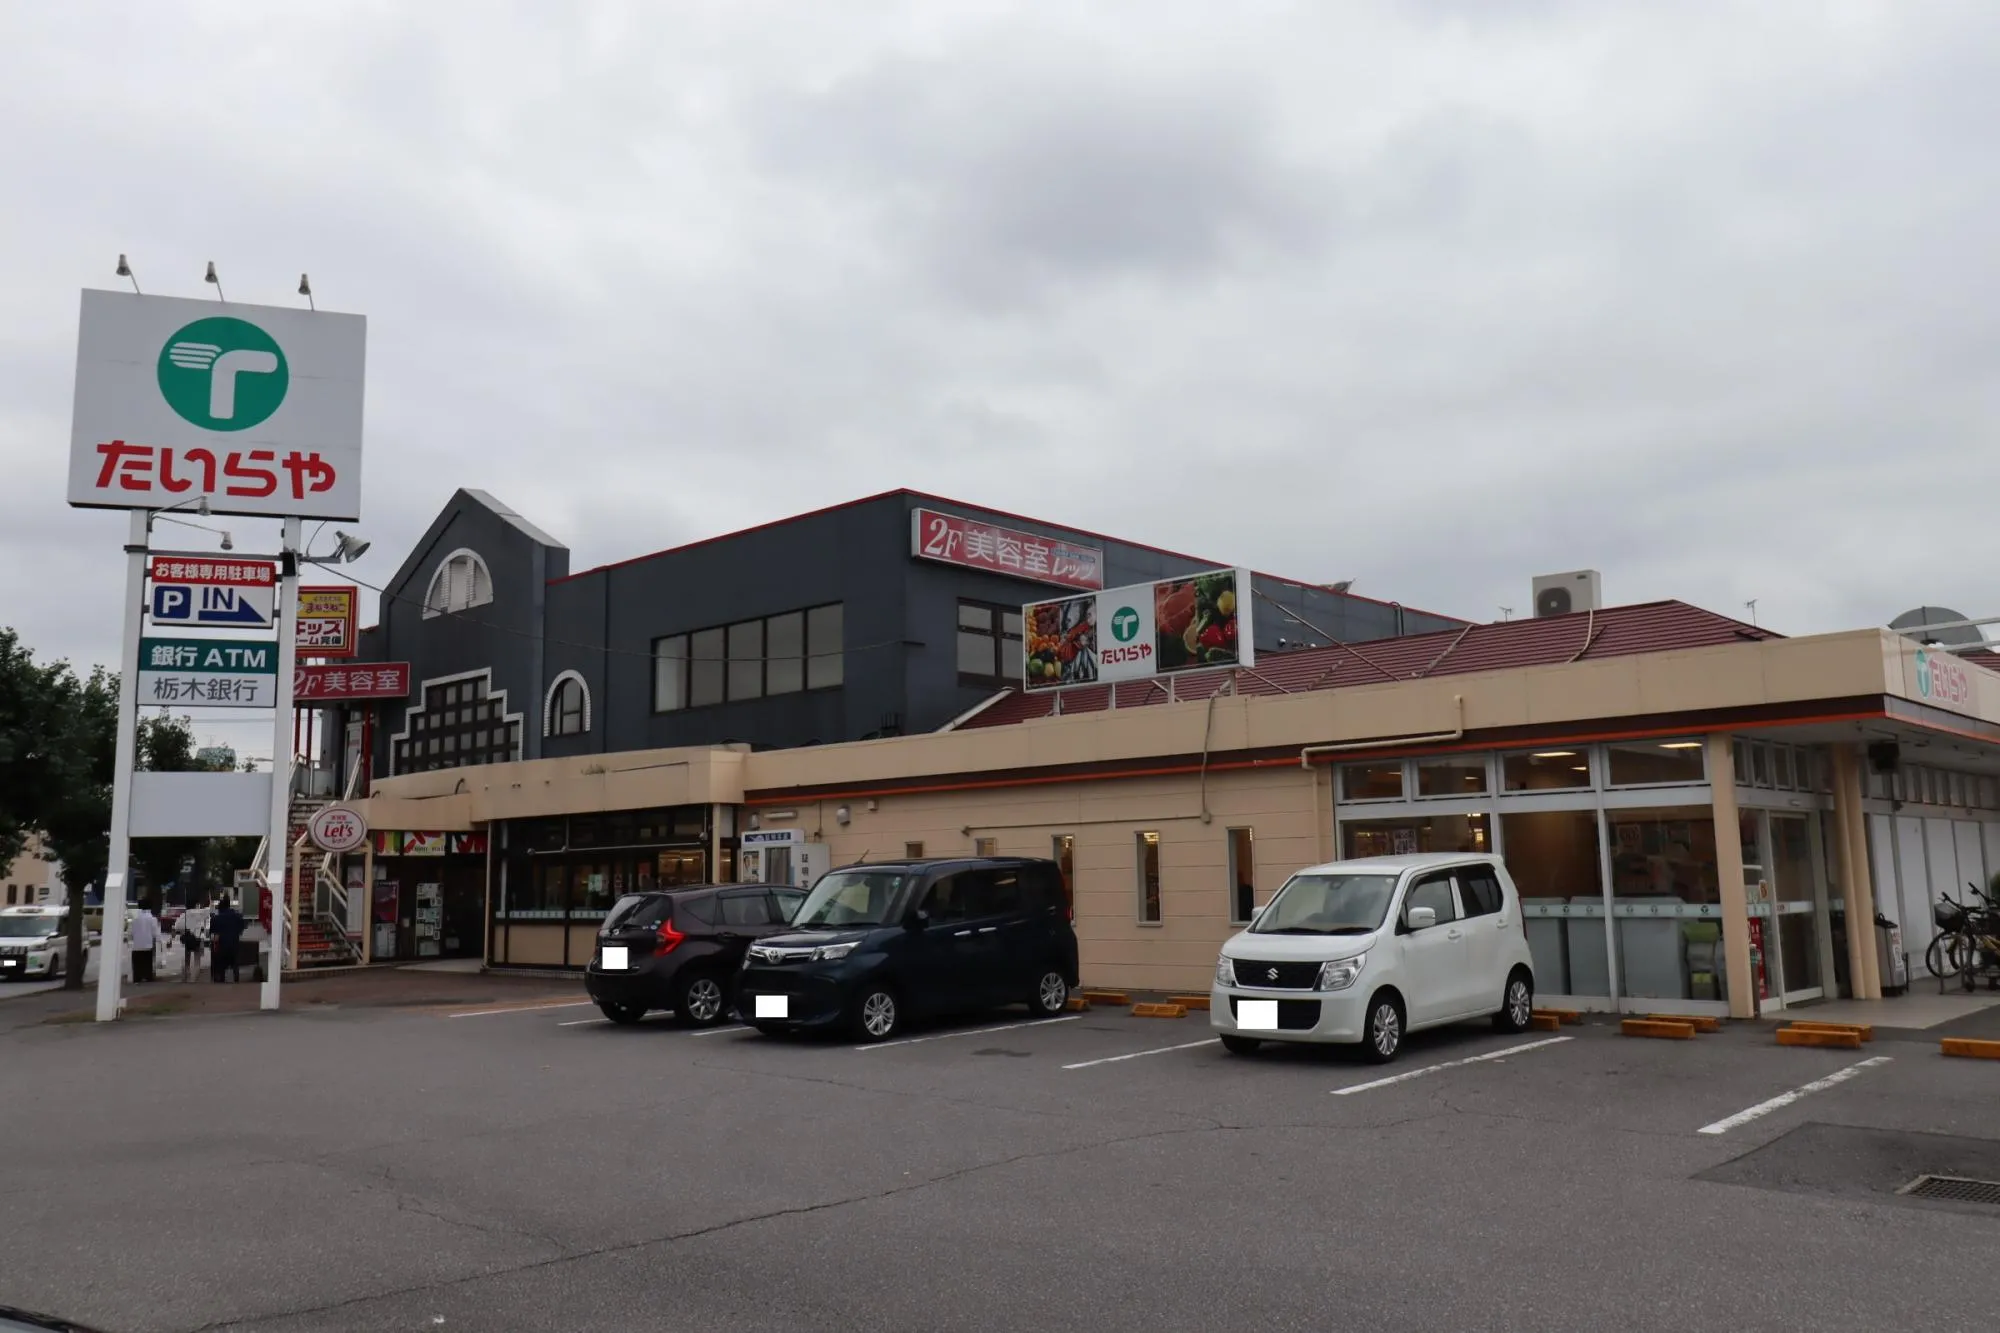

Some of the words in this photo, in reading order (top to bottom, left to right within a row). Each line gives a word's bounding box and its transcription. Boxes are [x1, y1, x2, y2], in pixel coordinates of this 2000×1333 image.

[96, 440, 336, 499] たいらや
[925, 518, 963, 558] 2F
[966, 529, 1050, 574] 美容室
[155, 563, 270, 582] お客様専用駐車場
[162, 590, 184, 614] P
[202, 587, 234, 610] IN
[151, 645, 198, 667] 銀行
[203, 648, 266, 668] ATM
[1101, 643, 1152, 666] たいらや
[153, 676, 259, 702] 栃木銀行
[324, 670, 400, 693] 美容室
[1929, 658, 1969, 704] たいらや
[324, 824, 354, 838] Let's
